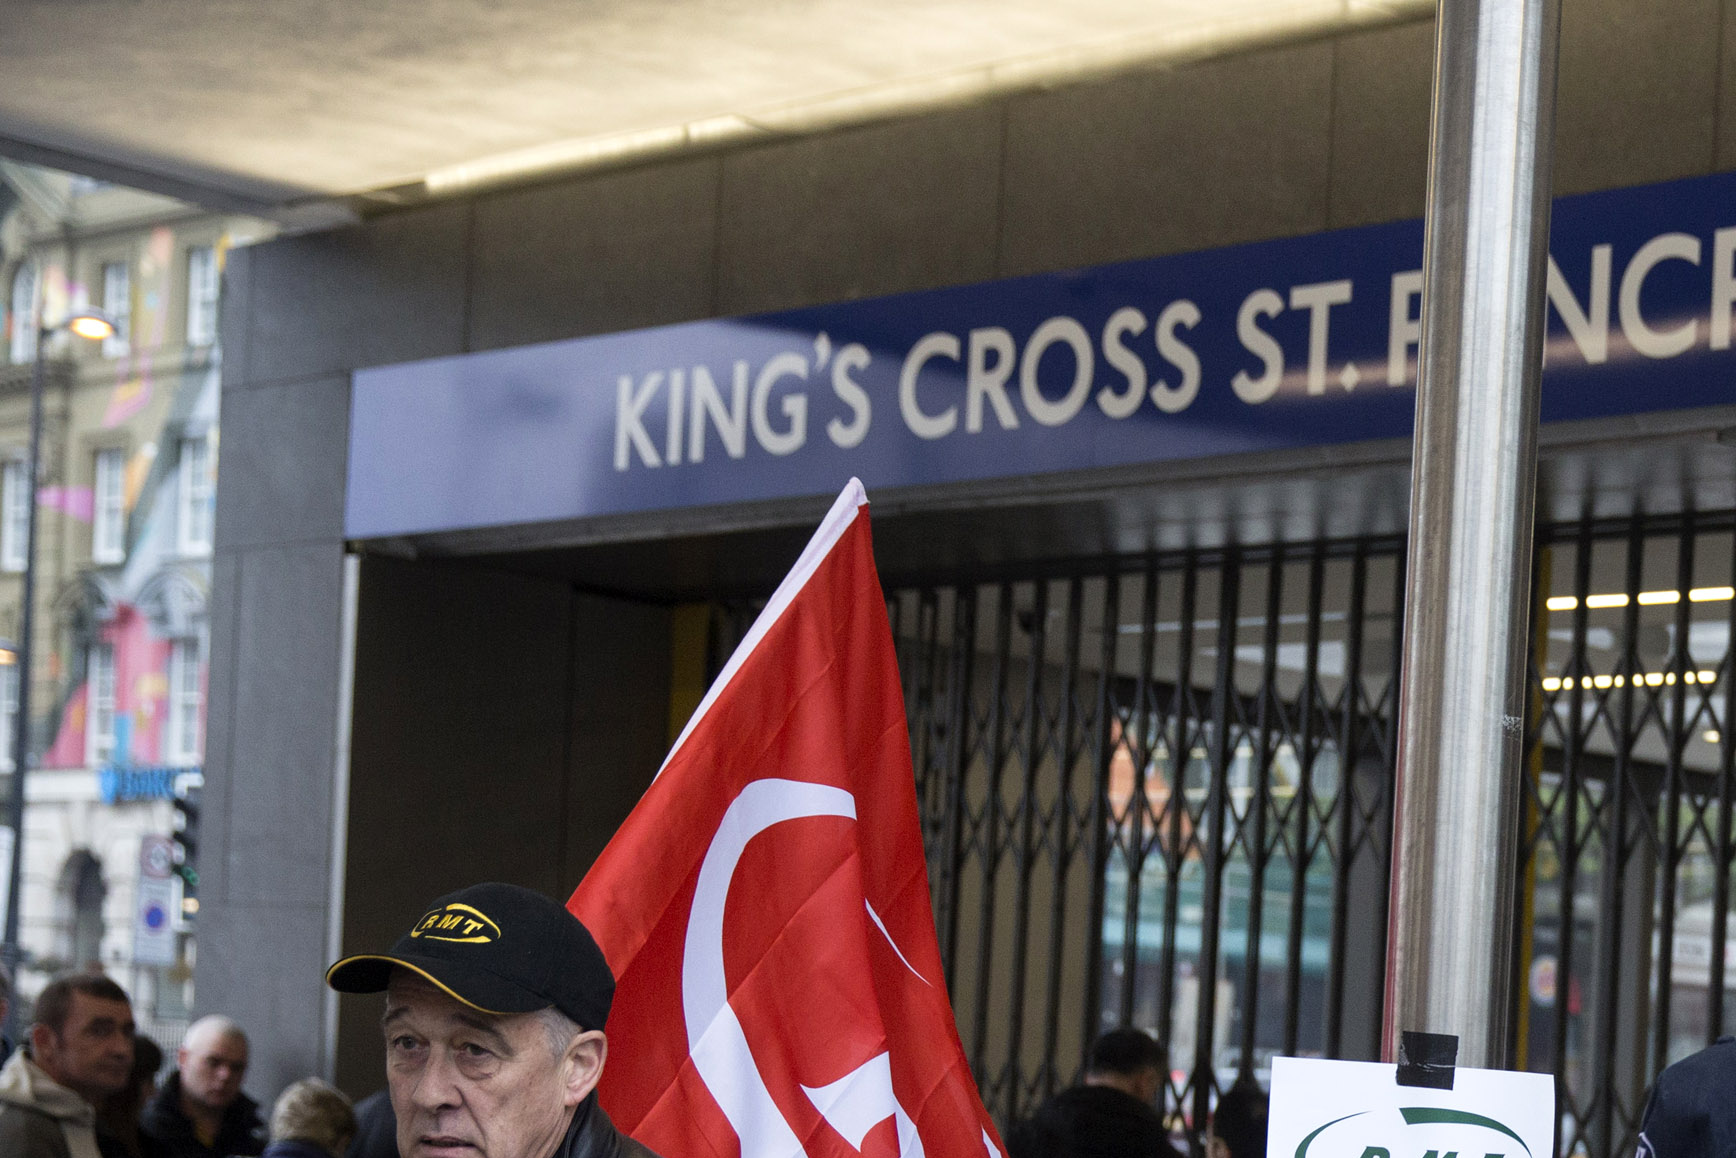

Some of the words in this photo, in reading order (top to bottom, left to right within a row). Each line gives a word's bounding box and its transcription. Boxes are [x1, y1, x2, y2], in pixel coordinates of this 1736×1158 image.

[613, 332, 872, 472] KING'S
[898, 299, 1202, 441] CROSS
[1230, 279, 1362, 405] ST.
[420, 913, 485, 936] RMT
